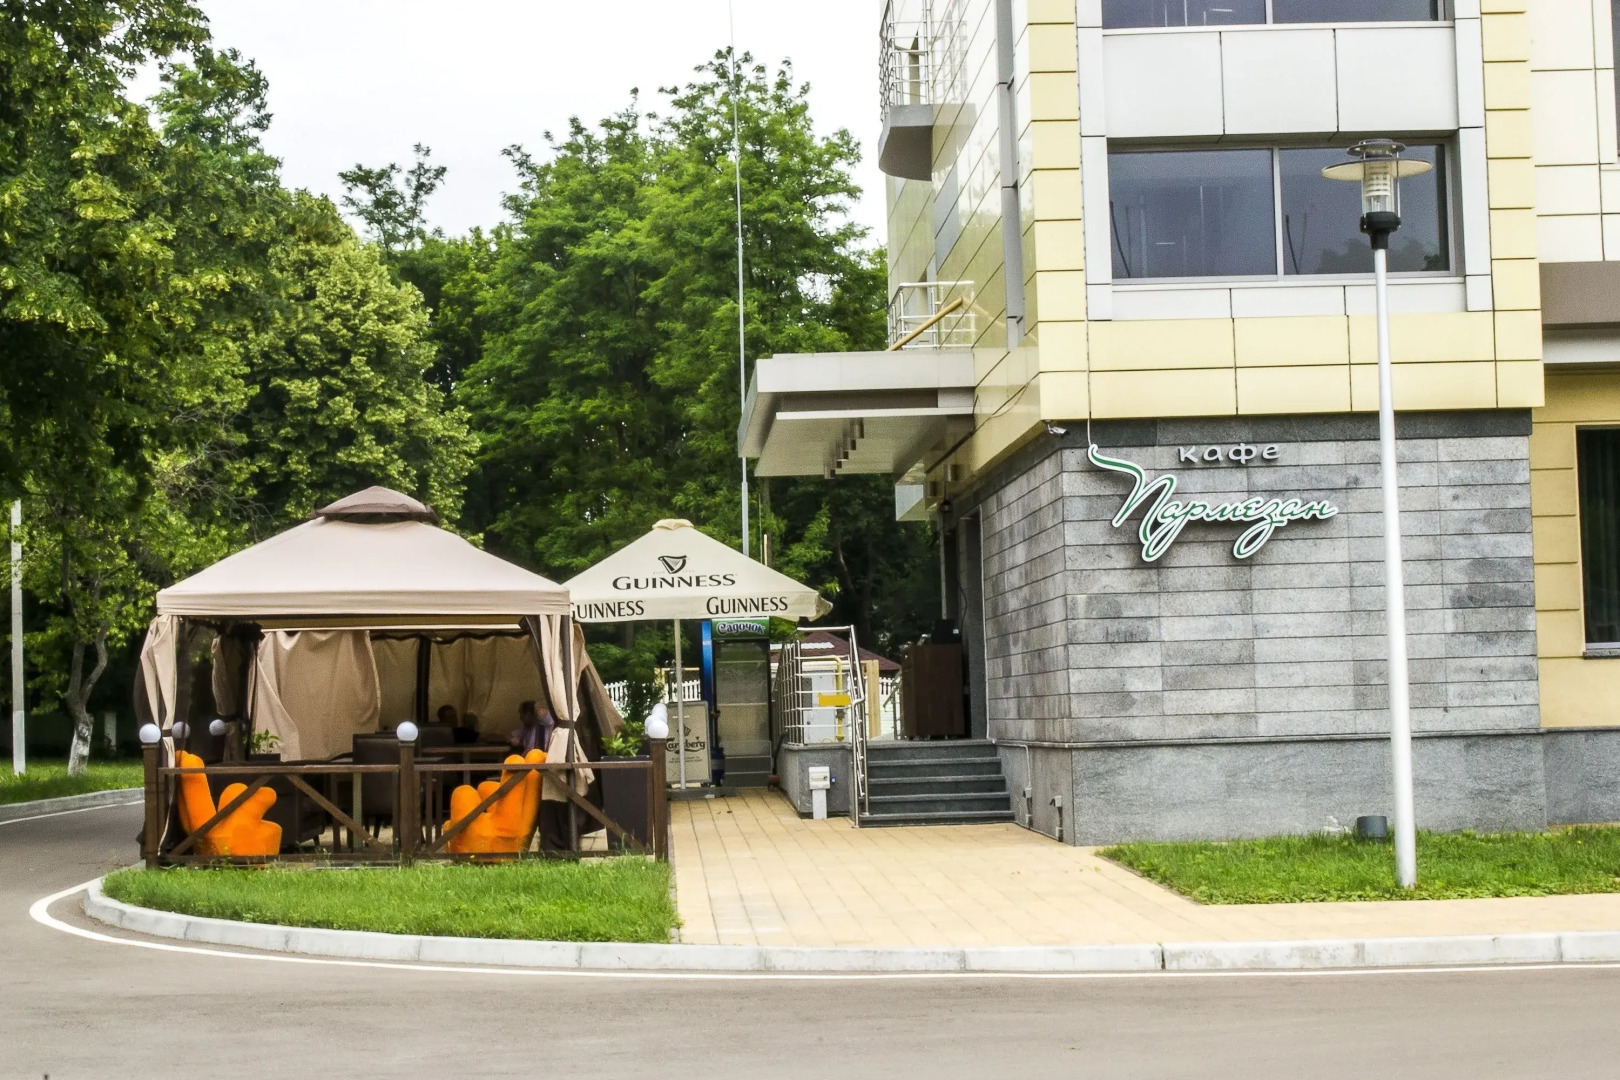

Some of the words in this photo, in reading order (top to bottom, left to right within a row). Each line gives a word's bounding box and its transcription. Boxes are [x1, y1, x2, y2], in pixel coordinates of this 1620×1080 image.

[1087, 443, 1338, 563] Пармезан
[612, 573, 736, 590] GUINNESS
[706, 596, 788, 615] GUINNESS
[716, 621, 766, 635] Садочок
[665, 736, 706, 754] Carberg
